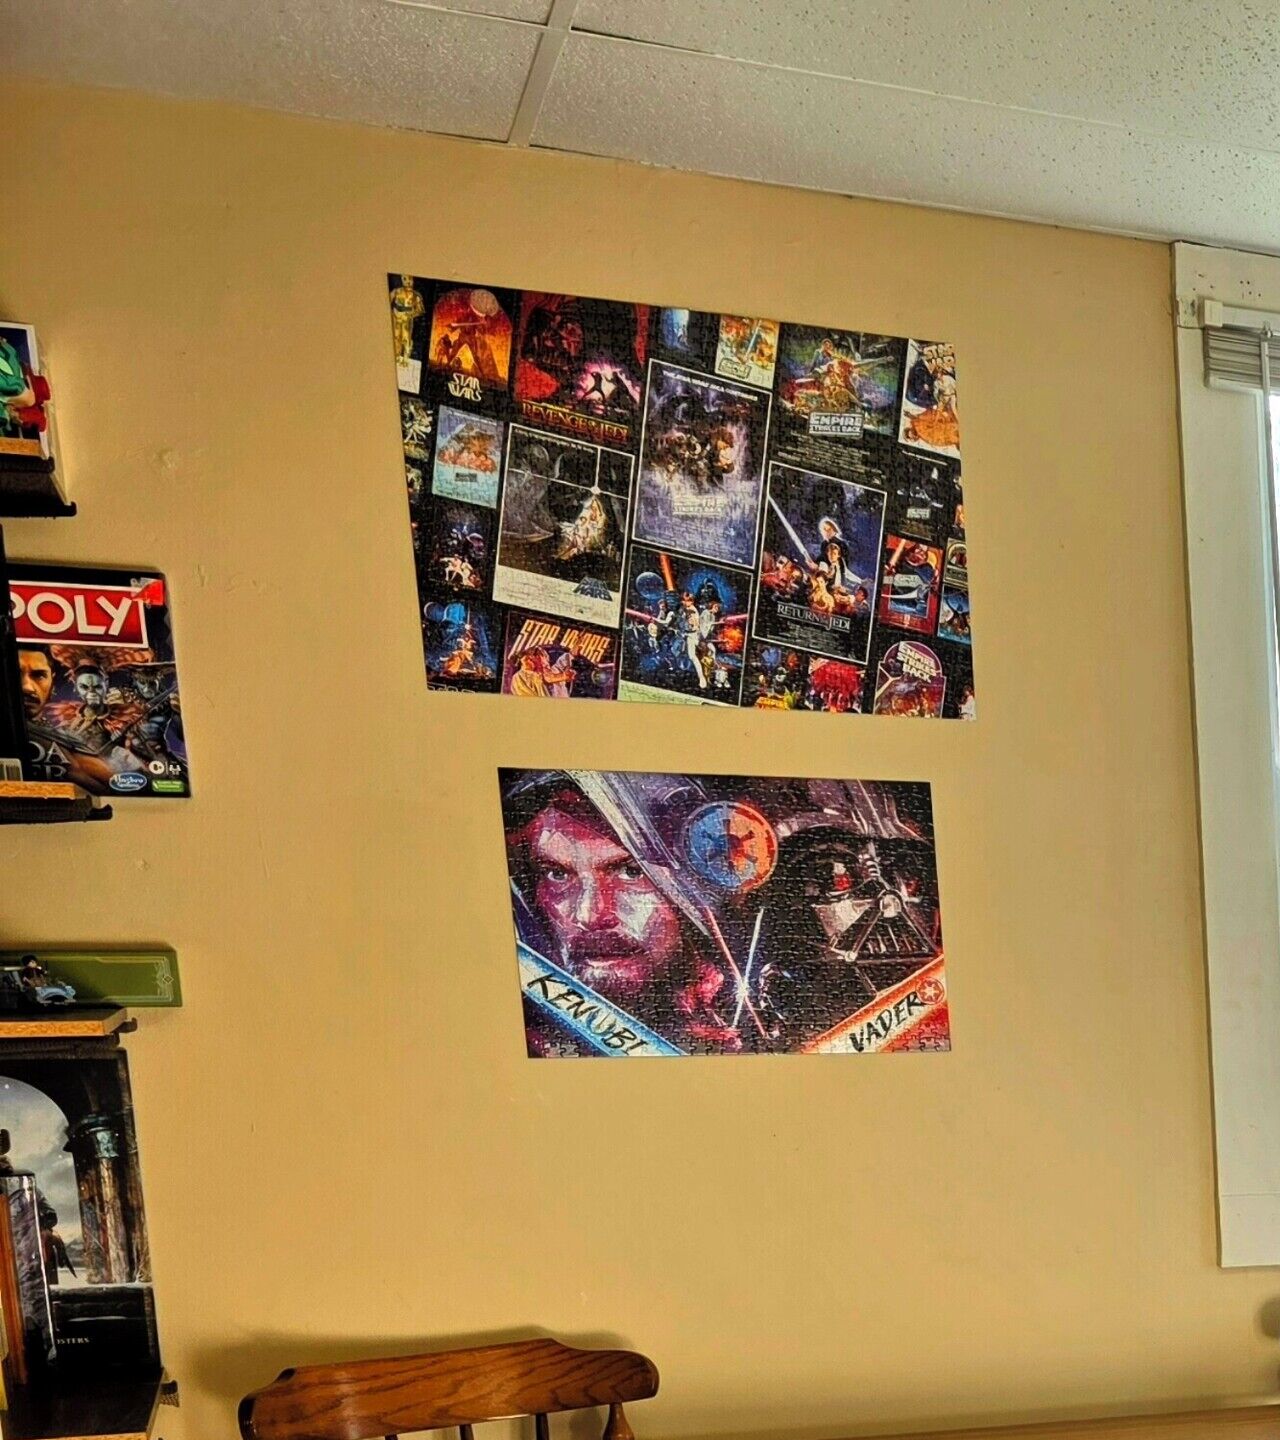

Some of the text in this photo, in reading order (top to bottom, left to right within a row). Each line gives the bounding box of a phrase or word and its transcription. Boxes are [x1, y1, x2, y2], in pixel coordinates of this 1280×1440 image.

[448, 382, 483, 402] WARS
[453, 372, 481, 391] STAR
[522, 402, 588, 432] REVENGE
[777, 604, 820, 622] RETURN
[825, 617, 851, 631] JEDI
[508, 619, 611, 663] STAR WARS
[849, 991, 926, 1053] VADER
